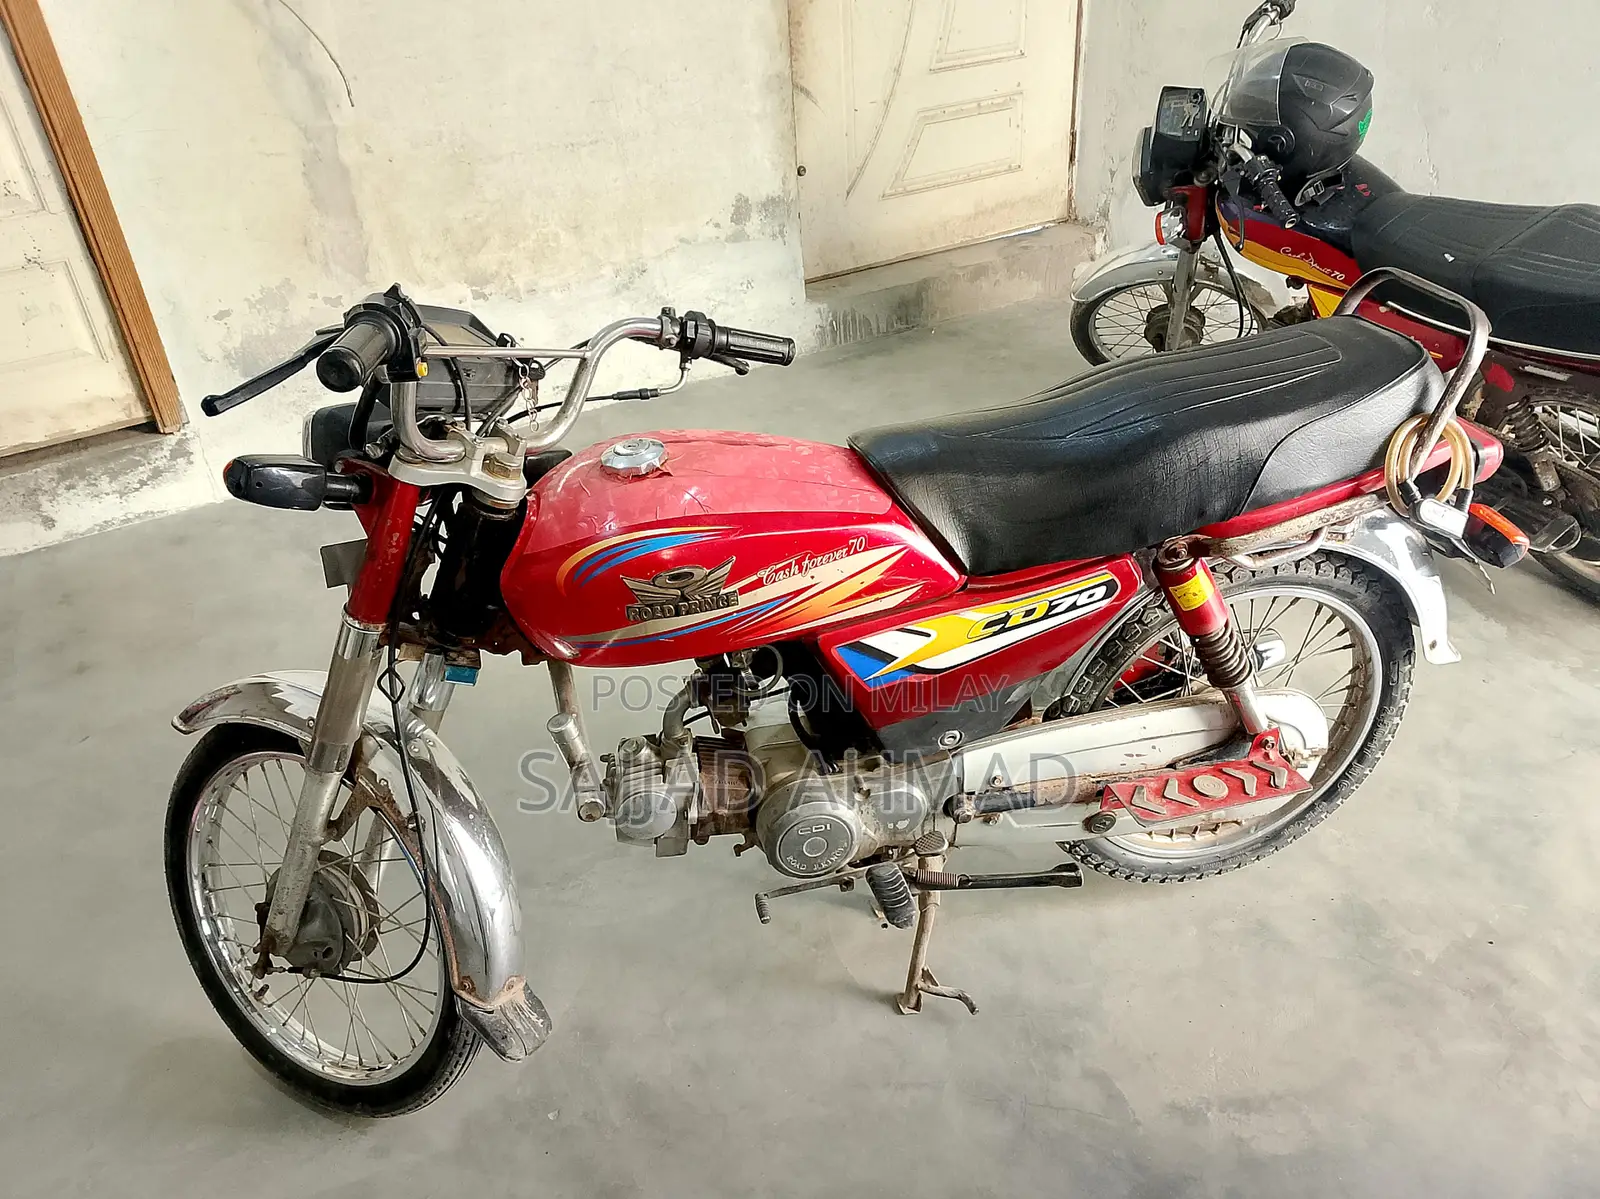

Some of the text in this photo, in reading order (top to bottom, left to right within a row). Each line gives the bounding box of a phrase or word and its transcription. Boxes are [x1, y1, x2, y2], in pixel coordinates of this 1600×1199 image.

[1331, 270, 1346, 281] 70
[757, 536, 866, 586] Cash forever 70
[627, 590, 739, 622] ROAD PRINCE
[967, 585, 1107, 639] CD70
[798, 823, 831, 835] CDI
